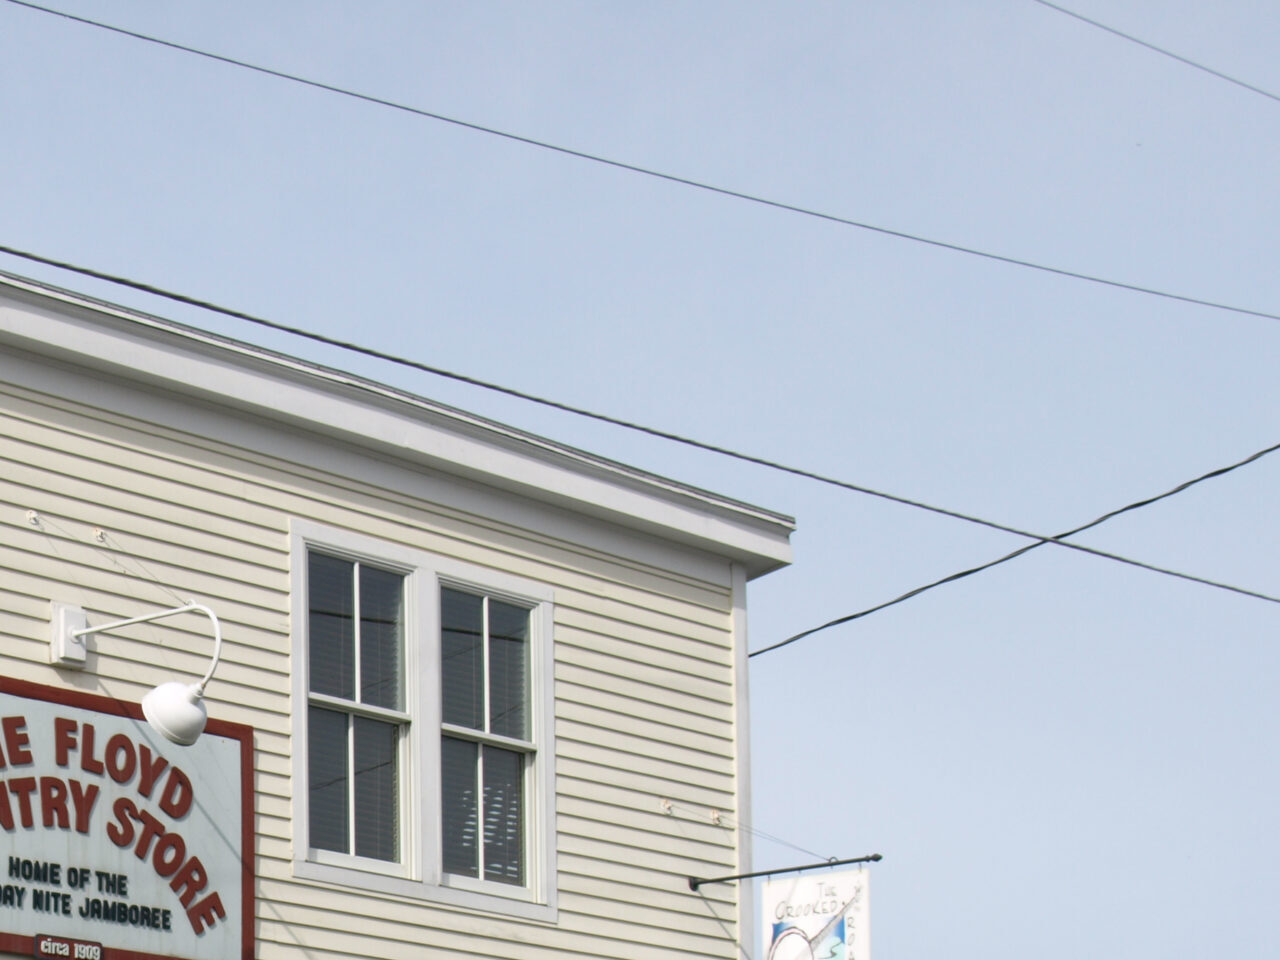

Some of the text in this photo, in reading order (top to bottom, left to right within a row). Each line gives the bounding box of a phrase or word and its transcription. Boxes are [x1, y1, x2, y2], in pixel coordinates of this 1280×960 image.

[53, 717, 194, 819] FLOYD
[8, 856, 129, 897] HOME OF THE
[106, 797, 226, 936] STORE
[32, 888, 72, 916] NITE
[79, 897, 172, 931] JAMBOREE
[775, 900, 838, 921] CROOKED
[40, 937, 70, 957] circa
